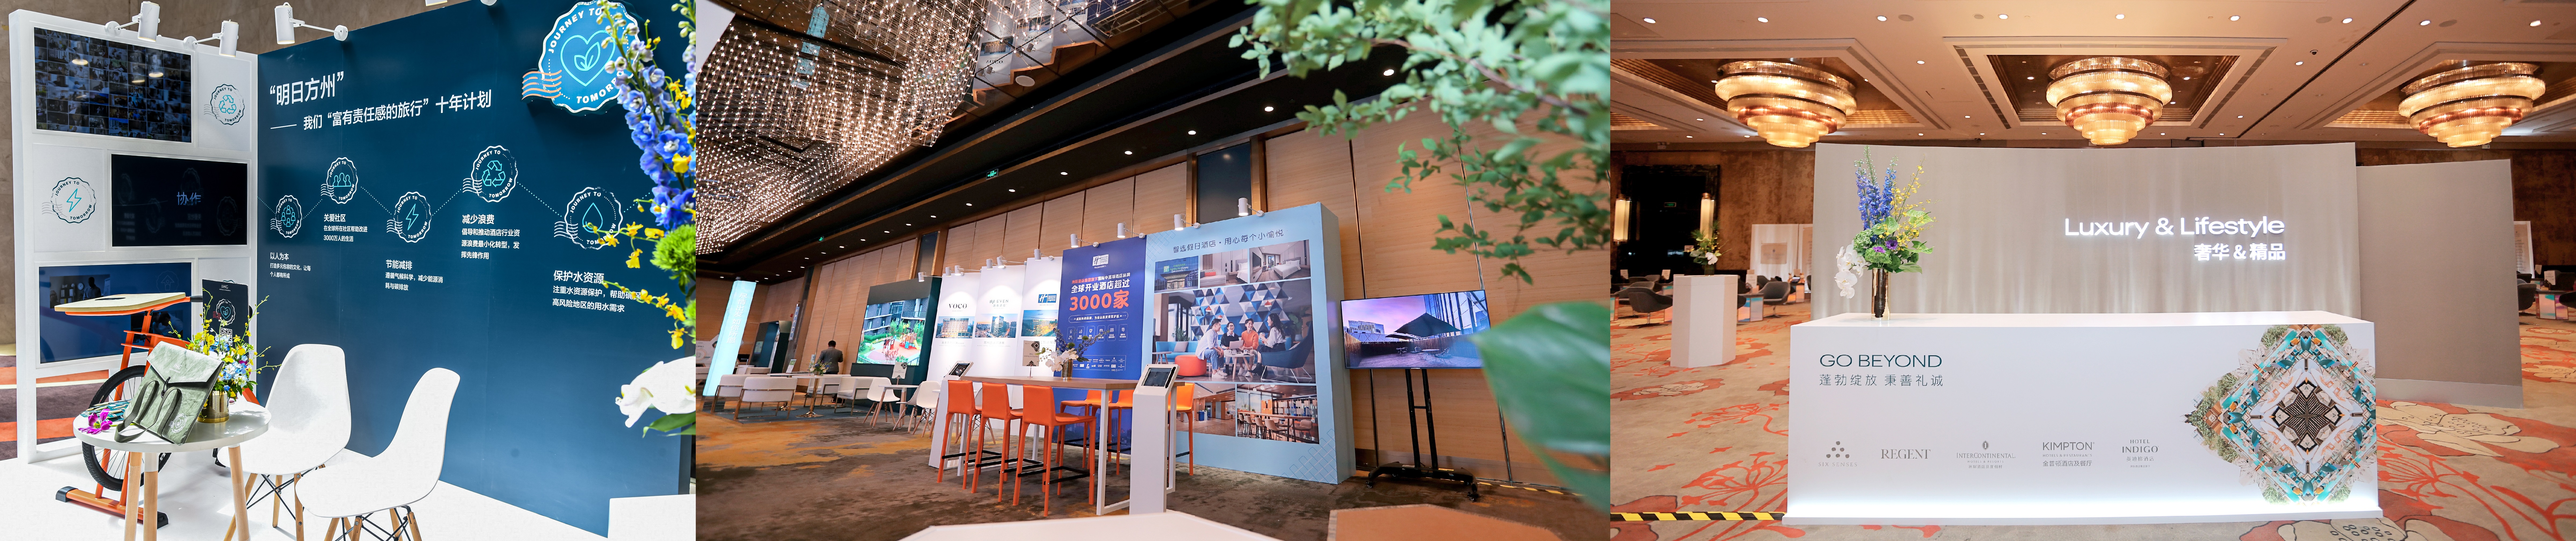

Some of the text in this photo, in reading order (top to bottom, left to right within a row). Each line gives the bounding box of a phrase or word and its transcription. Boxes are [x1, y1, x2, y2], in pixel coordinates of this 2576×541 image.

[548, 8, 602, 53] JOURNEY TO
[214, 87, 226, 100] JOURNEY
[270, 71, 344, 106] “明日方州”
[576, 71, 624, 104] TOMORRO
[225, 109, 241, 122] TOMORROW
[476, 150, 493, 170] JOURNEY
[329, 161, 341, 177] JOURNEY
[55, 181, 71, 196] JOURNEY
[339, 184, 355, 200] TOMORROW
[489, 177, 513, 198] TOMORROW
[177, 192, 201, 205] 协作
[397, 196, 411, 213] JOURNEY
[570, 192, 591, 213] JOURNEY
[70, 204, 92, 220] TOMORROW
[278, 199, 289, 213] JOURNEY
[324, 214, 346, 222] 关爱社区
[462, 214, 494, 225] 减少浪费
[286, 220, 299, 234] TOMORROW
[408, 221, 427, 239] TOMORROW
[462, 228, 520, 237] 倡导和推动酒店行业资
[2065, 216, 2284, 239] Luxury & Lifestyle
[461, 240, 520, 249] 源浪费最小化转型，发
[270, 252, 289, 261] 以人为本
[461, 251, 489, 260] 挥先锋作用
[2194, 243, 2285, 261] 奢华 & 精品
[270, 262, 311, 271] 打造多元包容的文化，让每
[386, 260, 412, 270] 节能减排
[385, 272, 443, 283] 遵循气候科学，减少能源消
[553, 270, 604, 284] 保护水资源
[385, 283, 408, 291] 耗与碳排放
[1071, 279, 1130, 293] 全球开业酒店超过
[552, 298, 625, 312] 高风险地区的用水需求
[1069, 289, 1129, 311] 3000家
[727, 293, 748, 344] 尽情出发 如你所愿
[1820, 354, 1942, 367] GO BEYOND
[1820, 374, 1943, 386] 蓬勃绽放 秉善礼诚
[1881, 449, 1931, 459] REGENT
